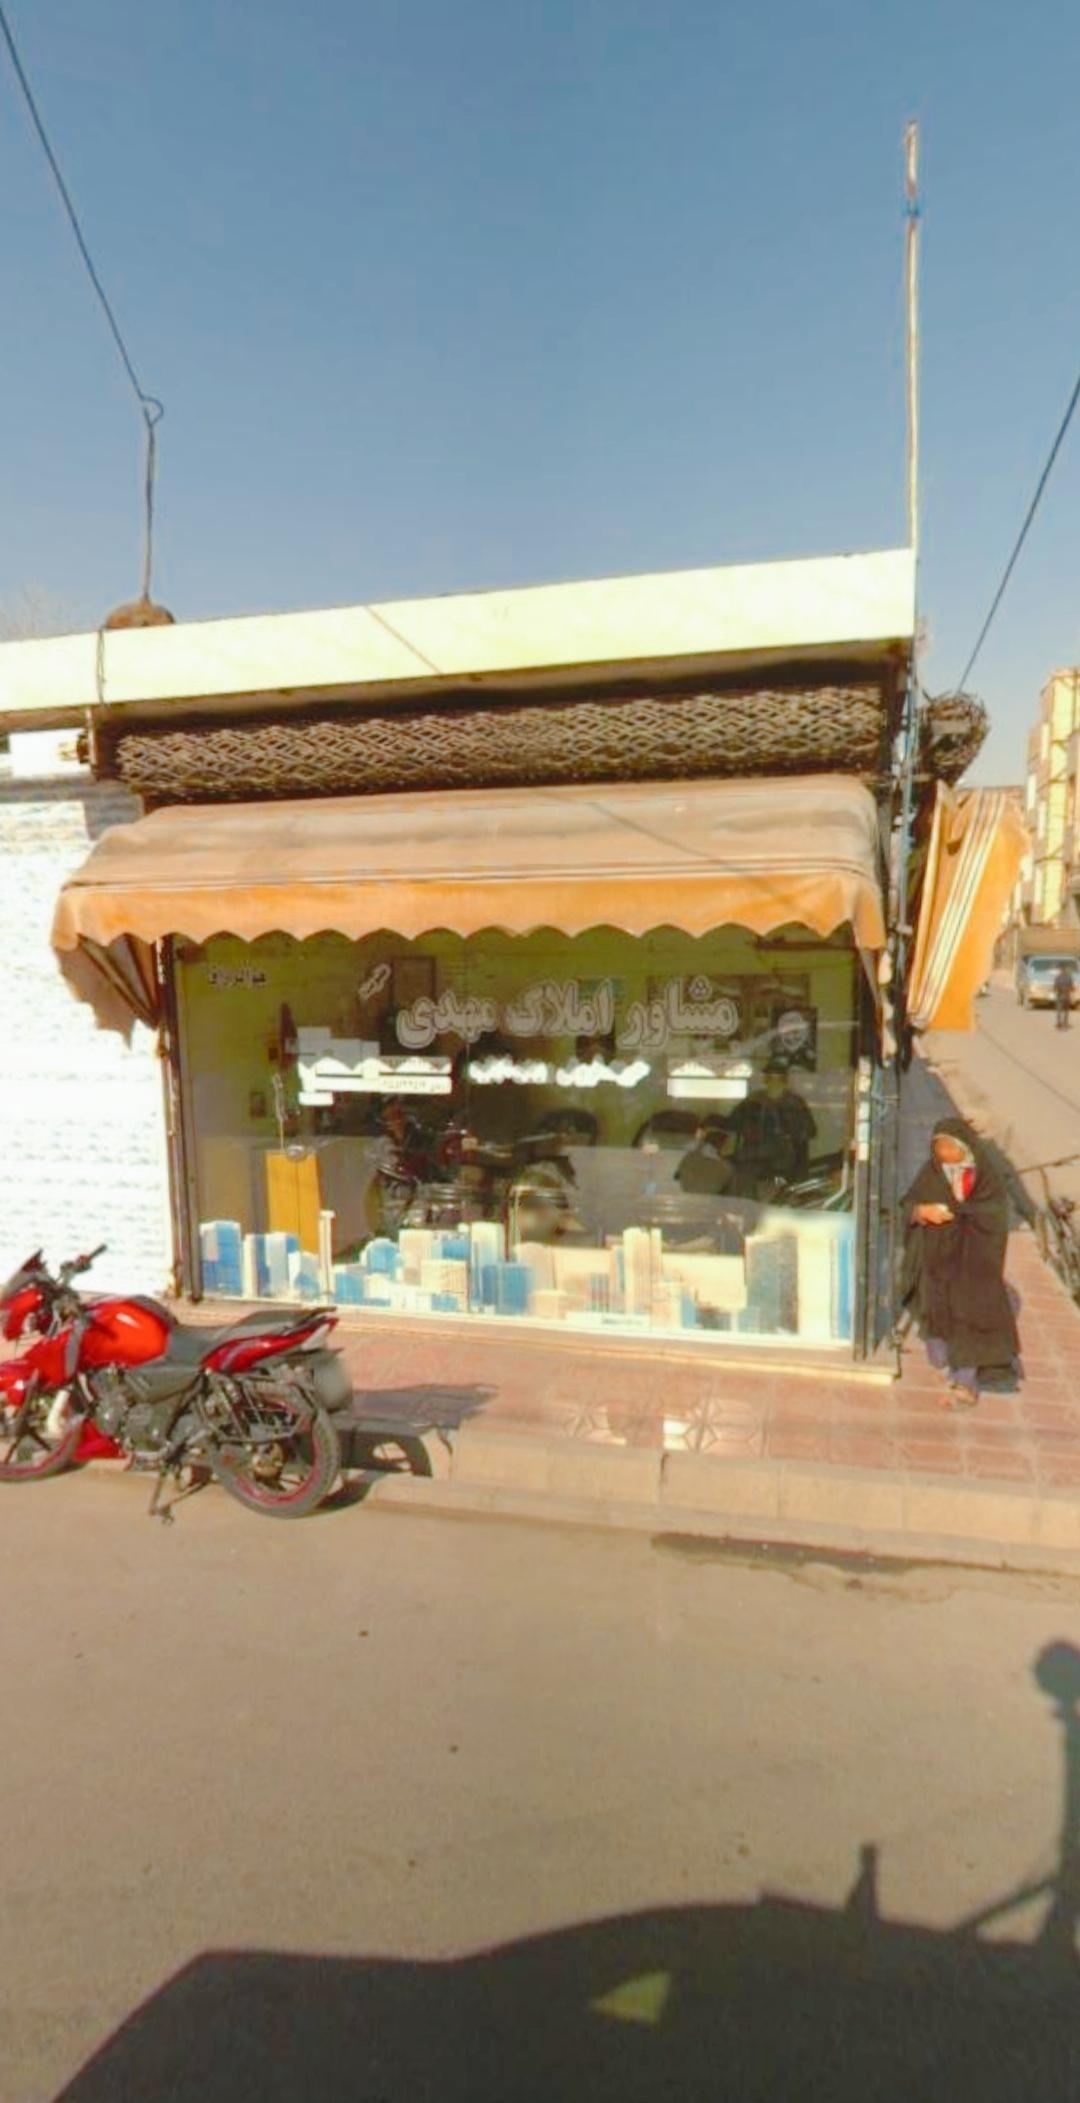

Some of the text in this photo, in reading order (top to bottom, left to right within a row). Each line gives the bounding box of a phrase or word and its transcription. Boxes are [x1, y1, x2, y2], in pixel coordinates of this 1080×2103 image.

[396, 976, 738, 1050] مشاور املاک مهدی
